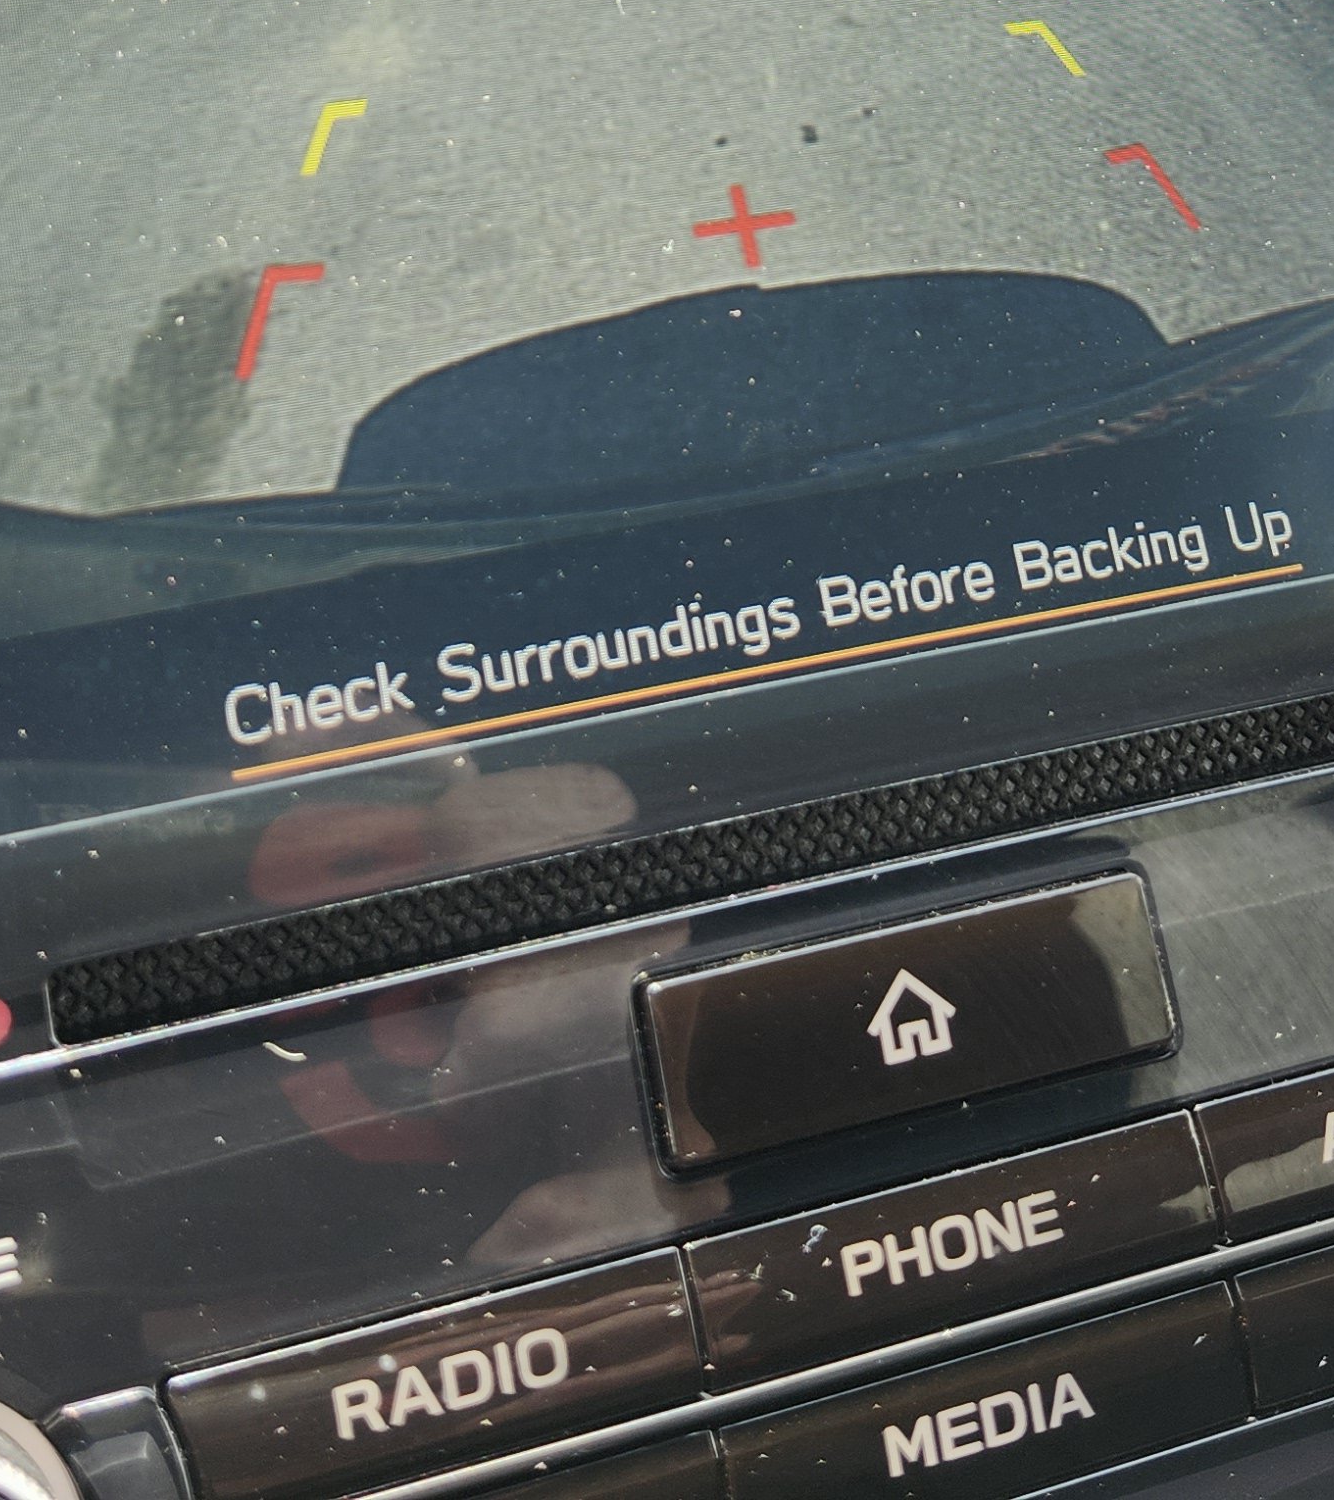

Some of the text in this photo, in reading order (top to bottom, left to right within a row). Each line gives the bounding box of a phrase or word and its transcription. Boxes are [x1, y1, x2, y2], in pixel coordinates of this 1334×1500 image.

[223, 501, 1294, 746] Check Surroundings Before Backing Up
[841, 1190, 1065, 1298] PHONE
[331, 1327, 570, 1440] RADIO
[882, 1372, 1096, 1478] MEDIA
